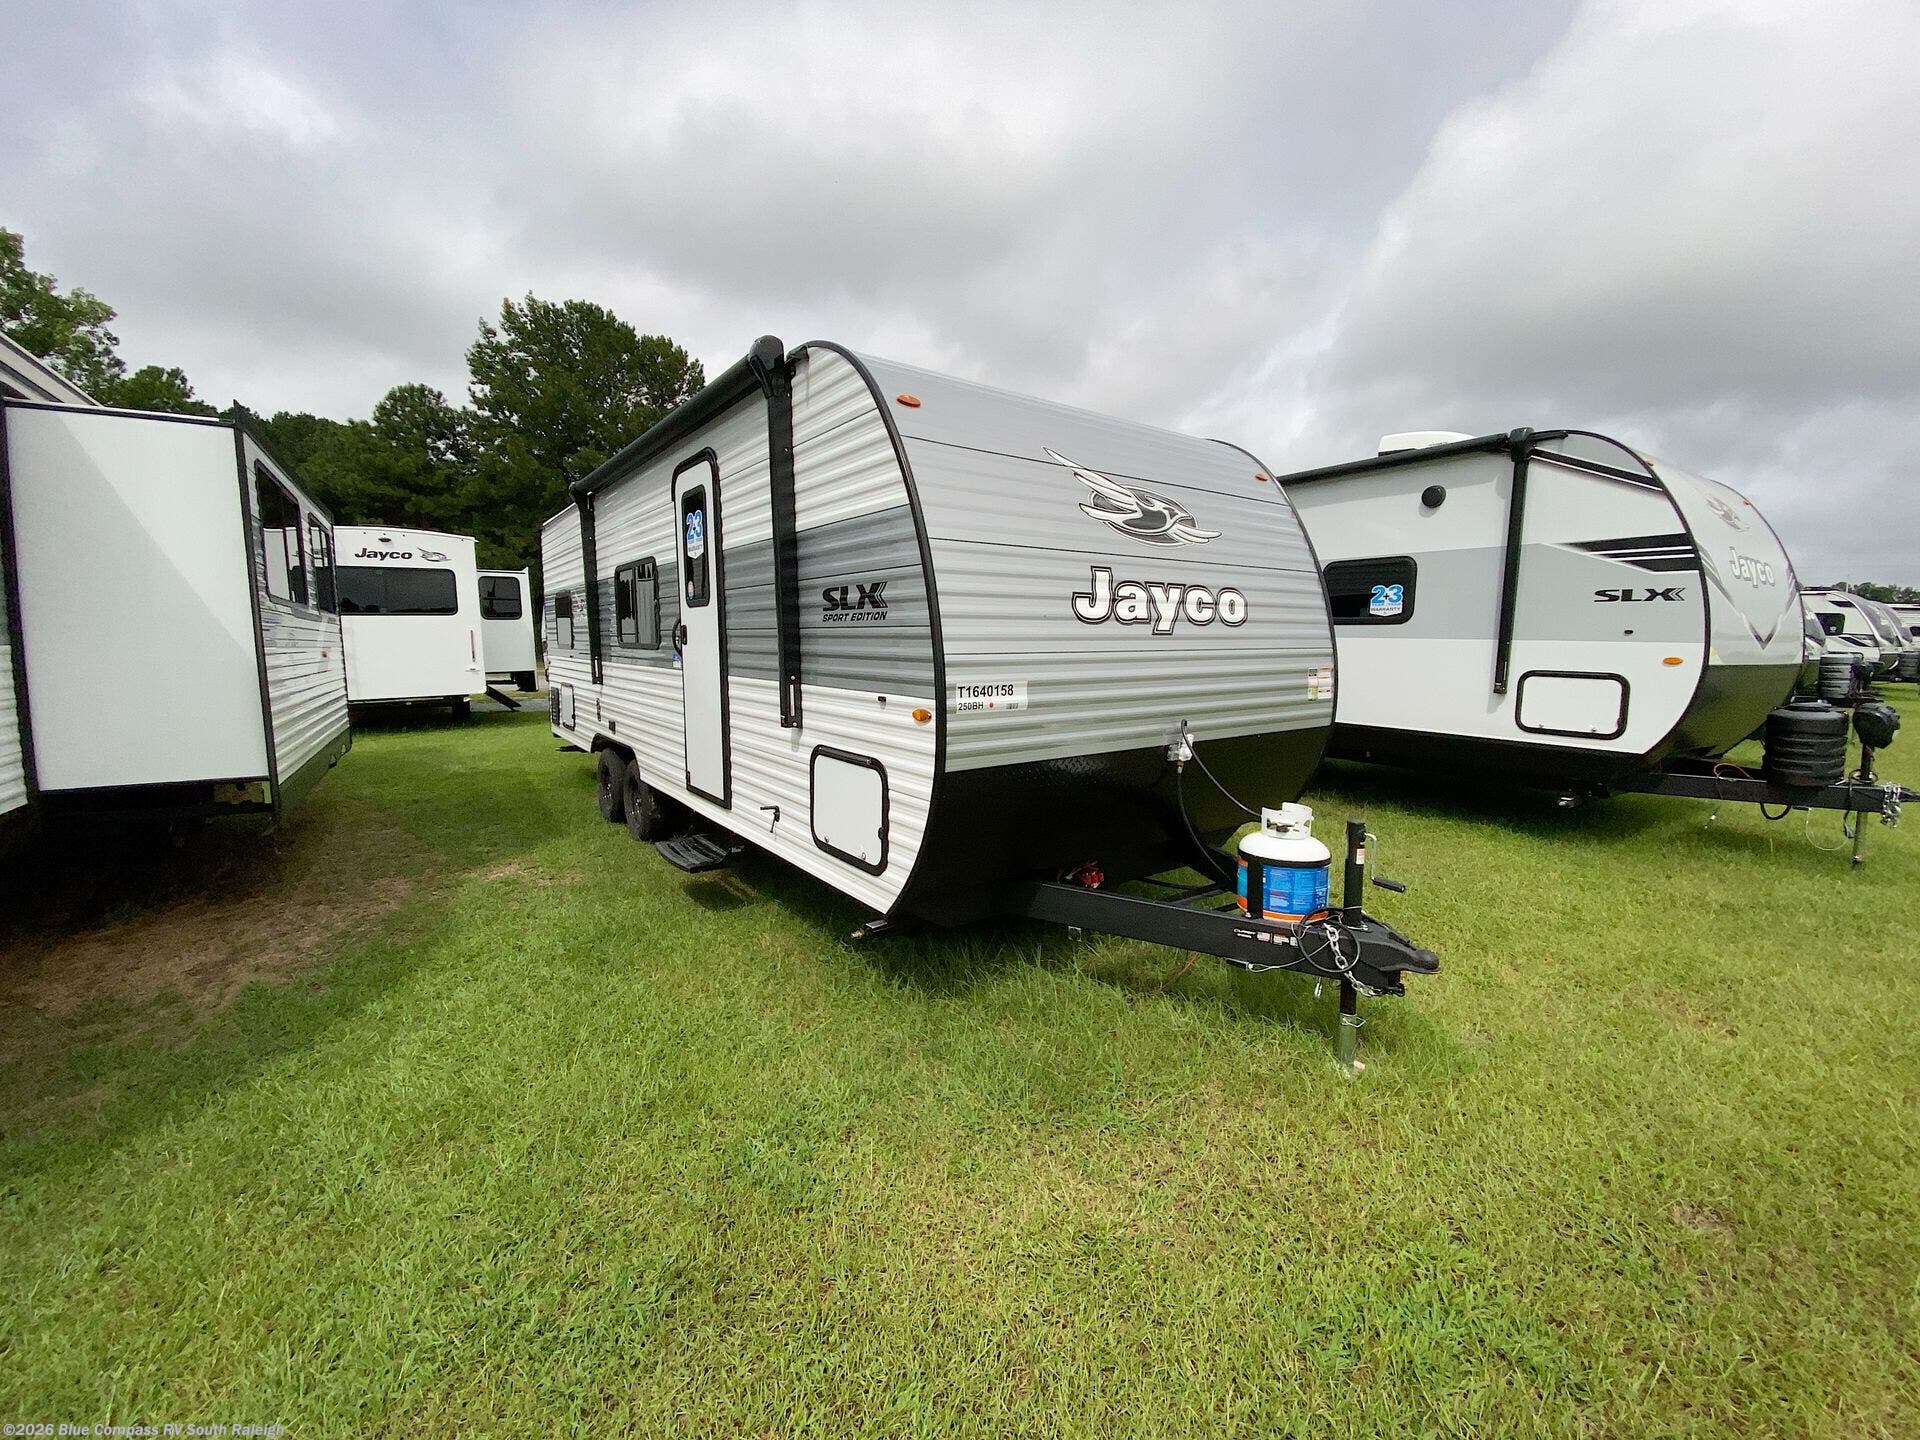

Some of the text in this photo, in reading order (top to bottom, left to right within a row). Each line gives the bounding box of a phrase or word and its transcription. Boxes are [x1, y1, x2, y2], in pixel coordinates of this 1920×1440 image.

[354, 547, 413, 560] Jayco
[1728, 546, 1775, 588] Jayco
[822, 581, 888, 611] SLX
[1072, 566, 1248, 635] Jayco
[1594, 588, 1685, 602] SLX
[822, 611, 888, 622] SPORT EDITION
[957, 684, 1014, 698] T1640158
[958, 701, 984, 711] 250BH
